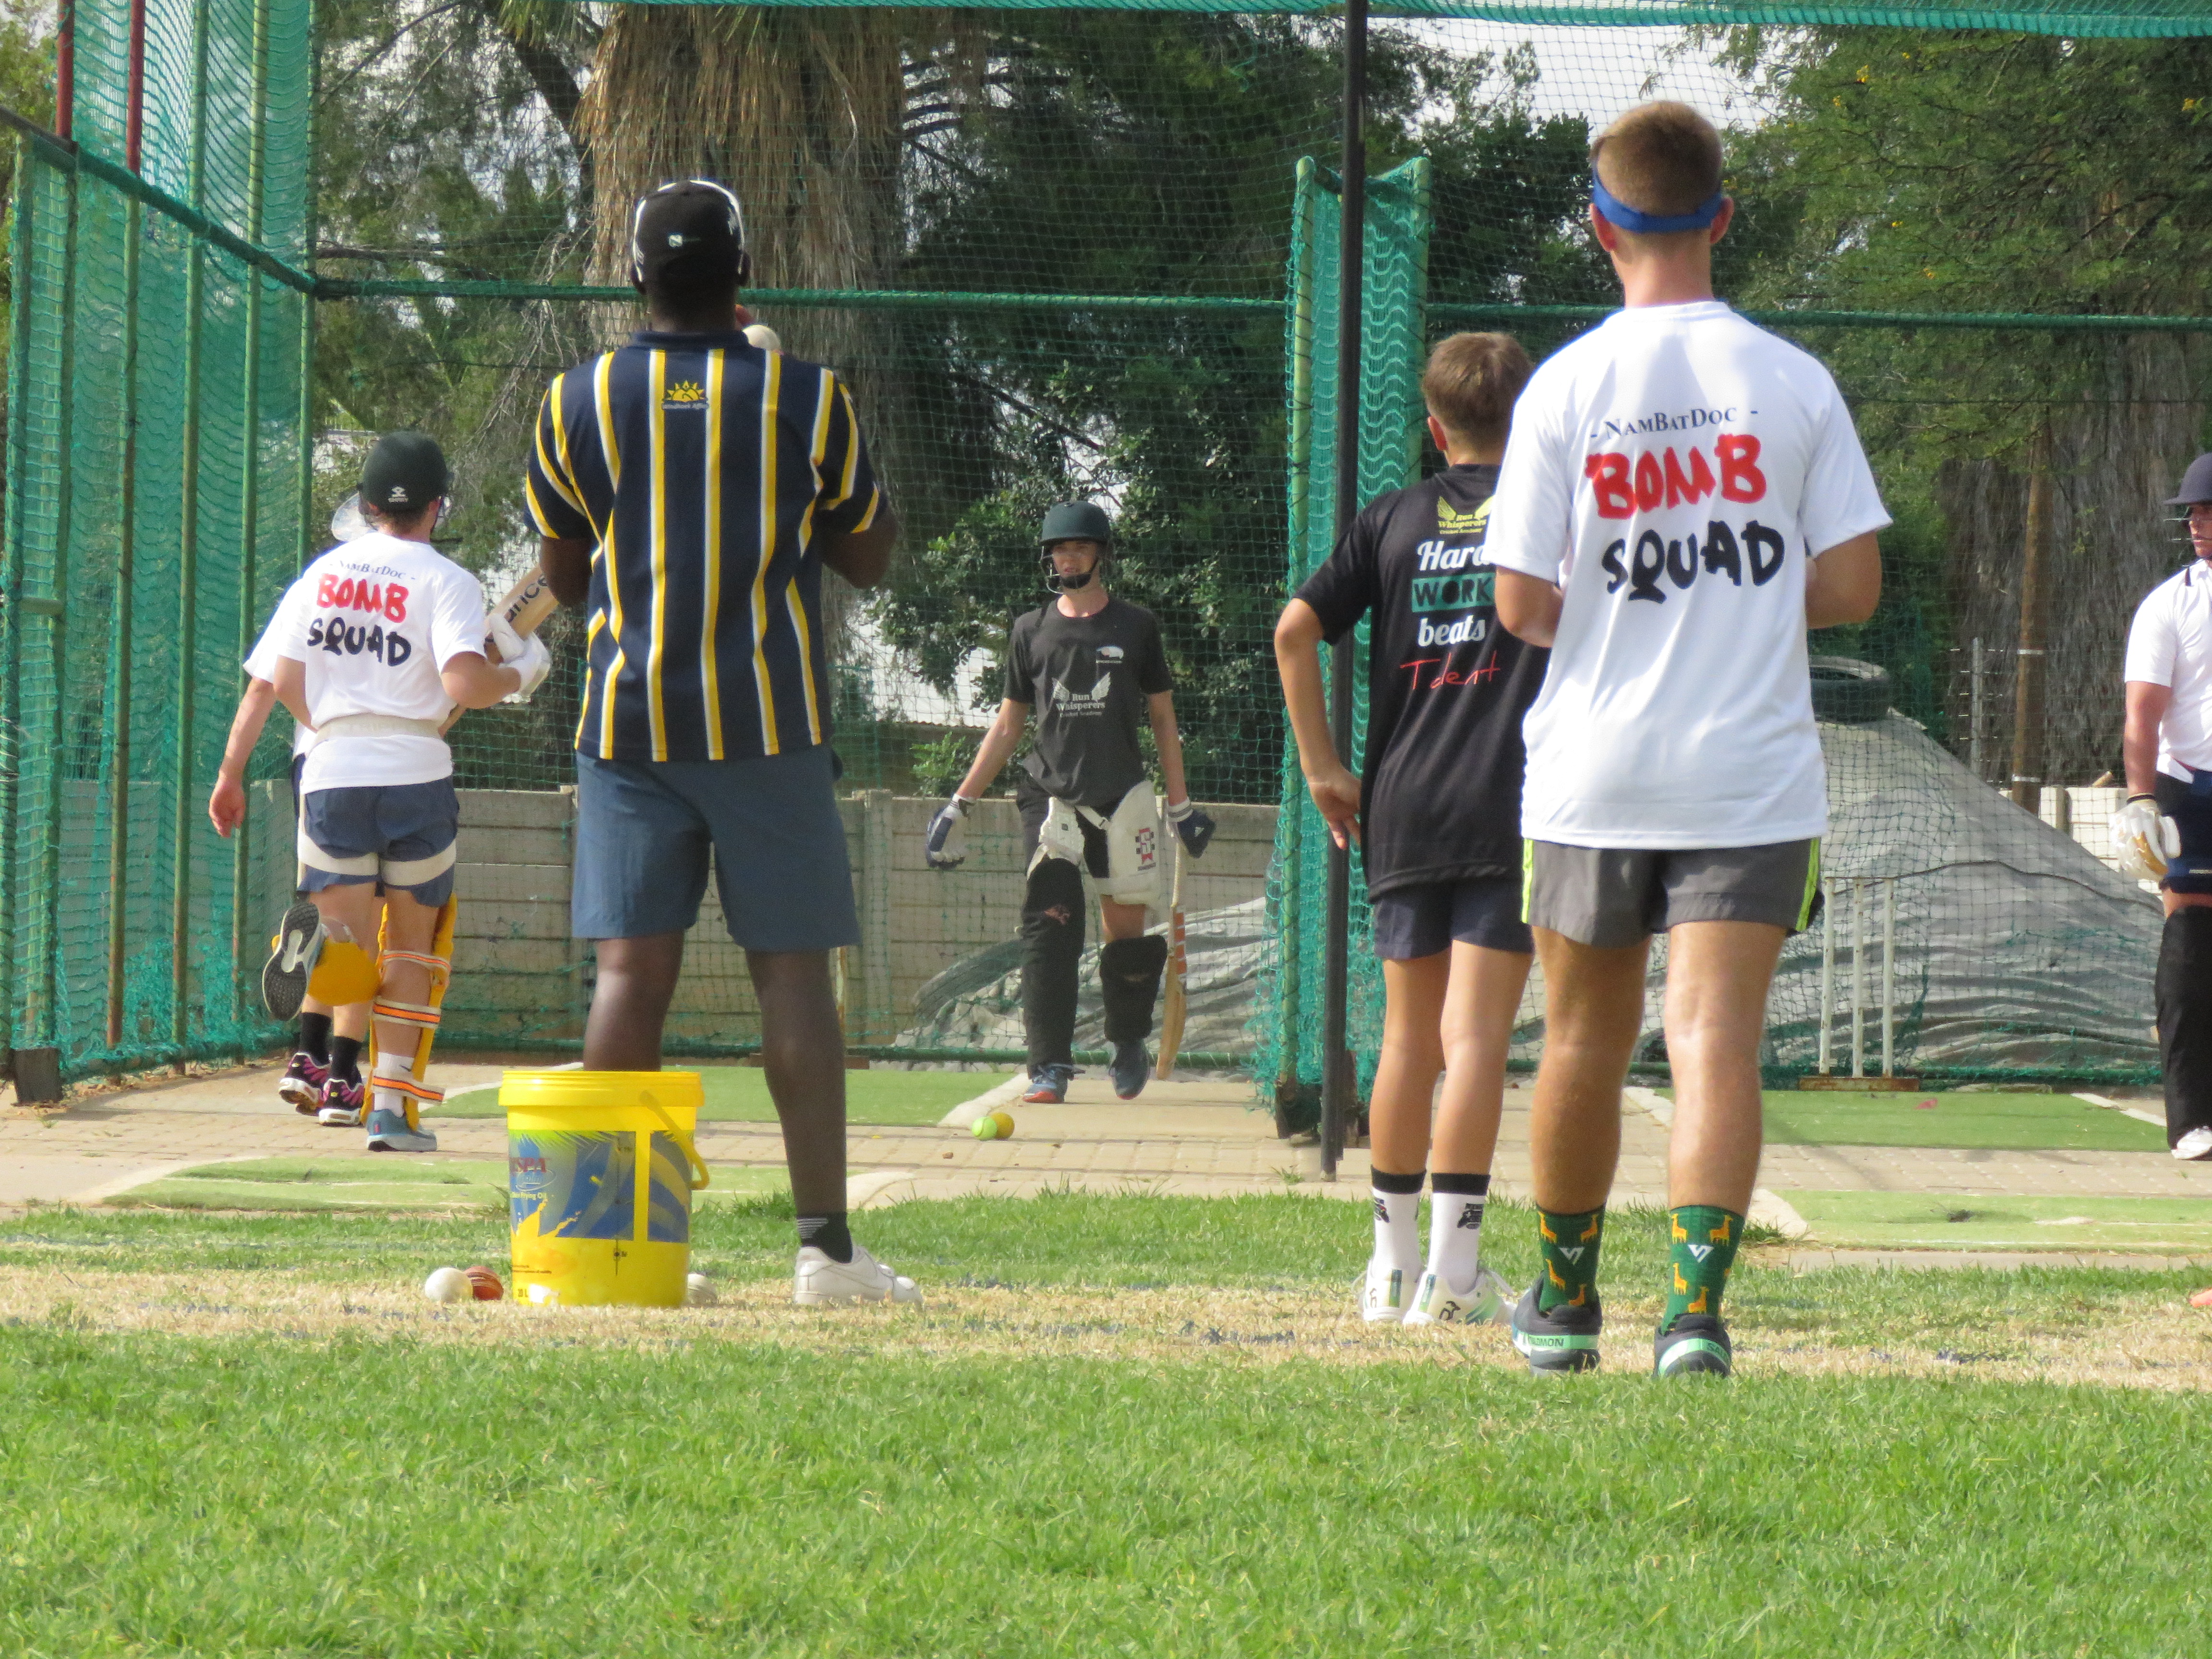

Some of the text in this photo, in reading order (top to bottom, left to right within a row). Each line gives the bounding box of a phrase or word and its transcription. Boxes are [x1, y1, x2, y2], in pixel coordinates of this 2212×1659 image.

[1585, 433, 1767, 519] BOMB
[1602, 520, 1785, 604] SQUAD
[317, 573, 409, 623] BOMB
[1414, 577, 1492, 607] WORK
[307, 617, 412, 667] SQUAD
[1418, 614, 1486, 647] beats
[1056, 701, 1106, 711] Whisperers
